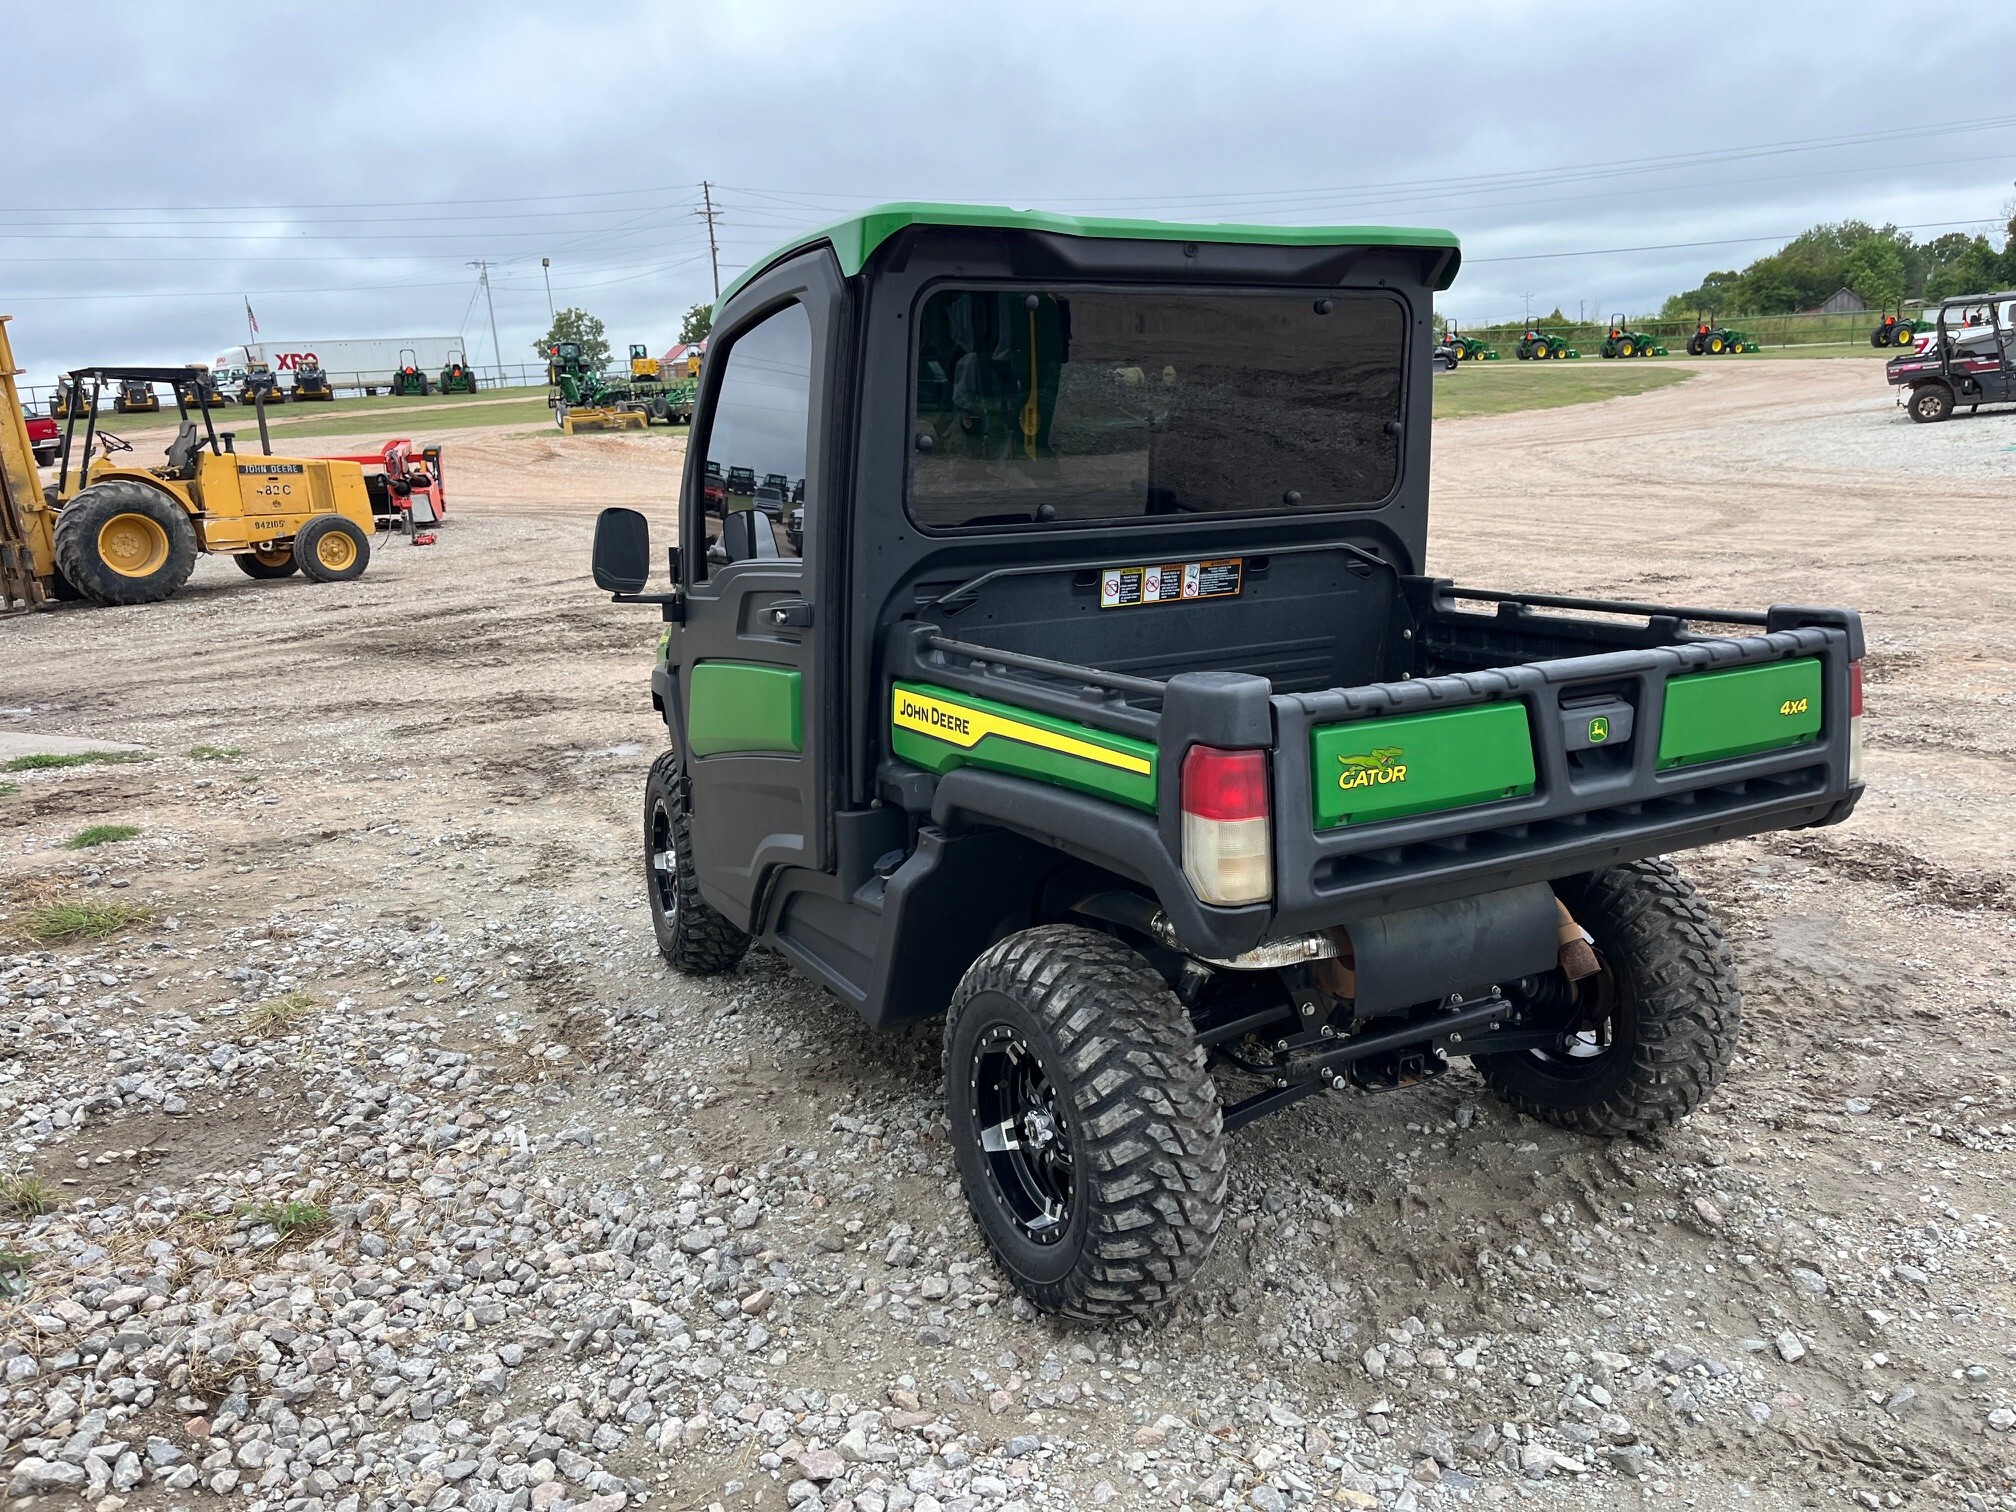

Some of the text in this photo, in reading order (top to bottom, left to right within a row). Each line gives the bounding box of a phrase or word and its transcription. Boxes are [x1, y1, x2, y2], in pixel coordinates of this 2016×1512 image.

[275, 352, 319, 371] XPO
[244, 464, 299, 474] JOHN DEERE
[900, 698, 970, 735] JOHN DEERE
[1338, 764, 1408, 790] GATOR
